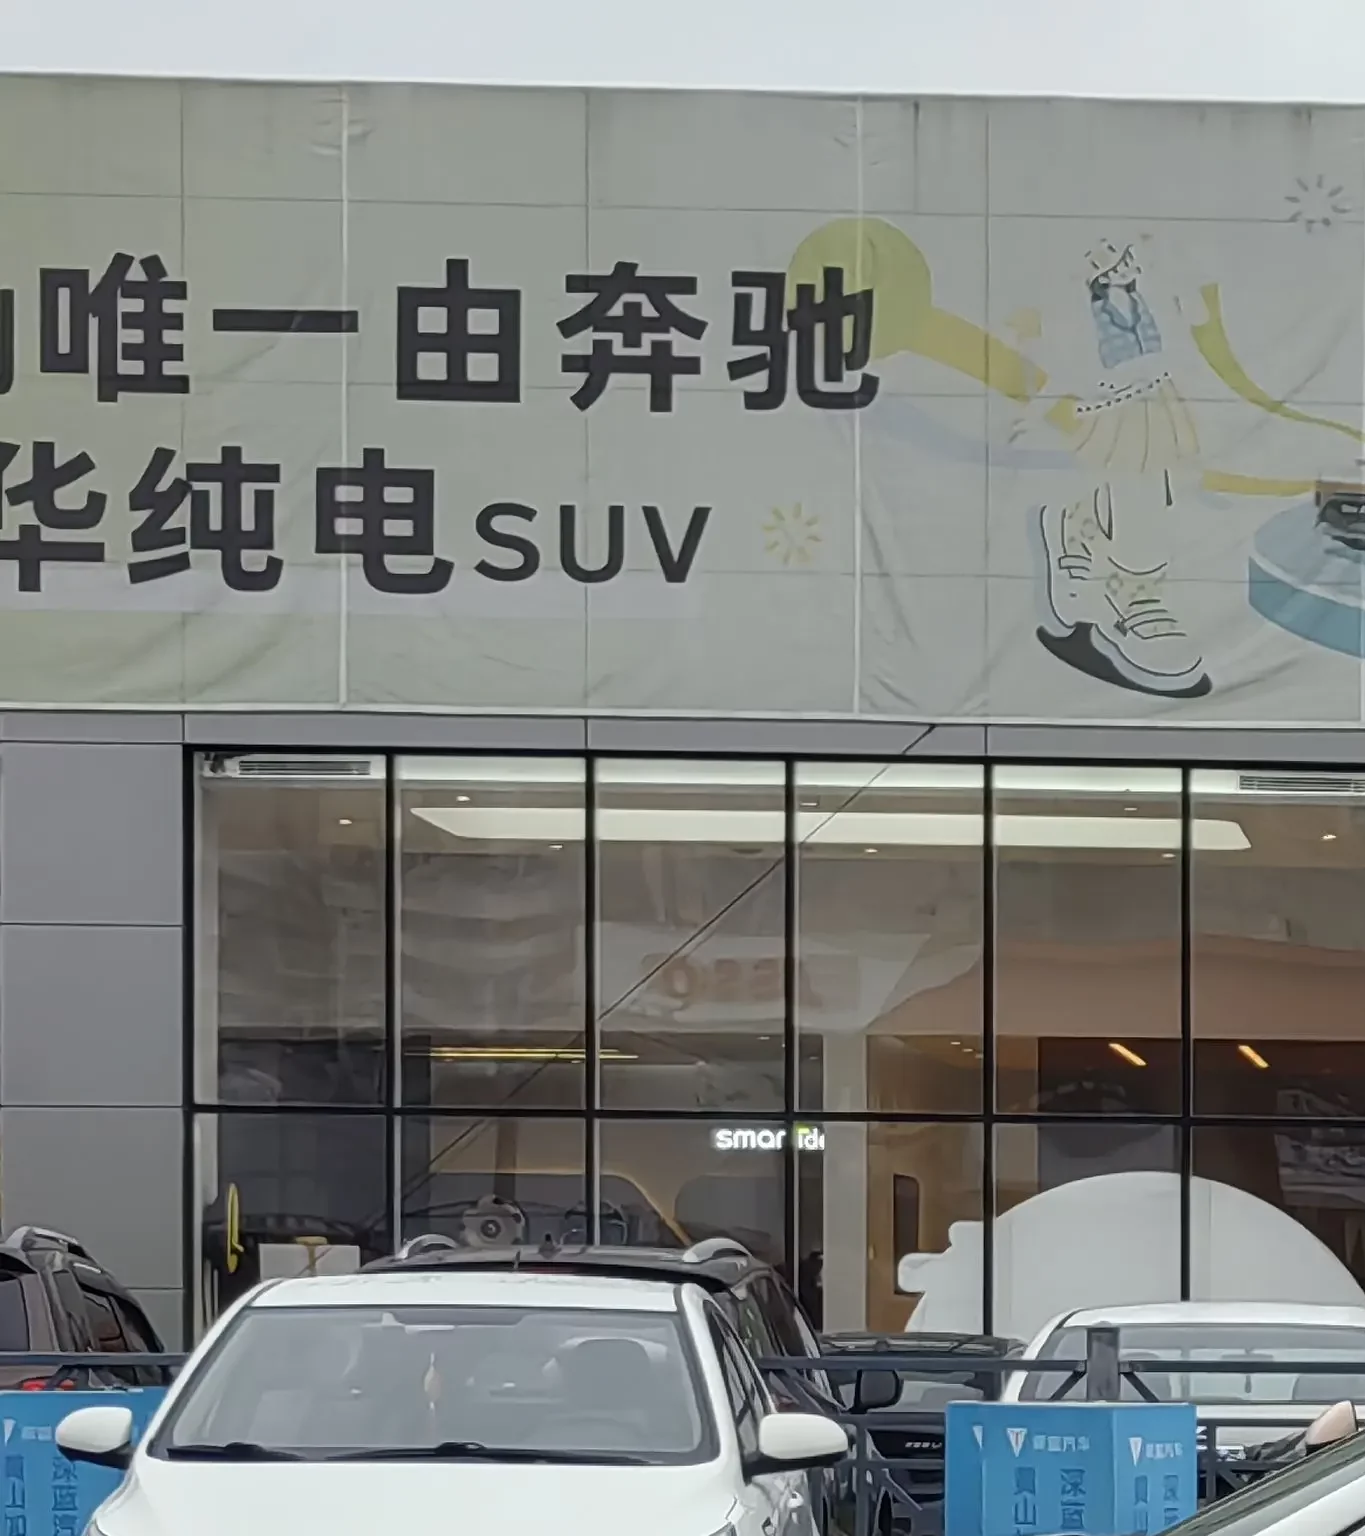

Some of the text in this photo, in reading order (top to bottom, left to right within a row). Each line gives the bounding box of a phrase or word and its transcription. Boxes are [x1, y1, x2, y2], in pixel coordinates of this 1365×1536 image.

[0, 252, 880, 413] 唯一由奔驰
[715, 1128, 787, 1150] smar
